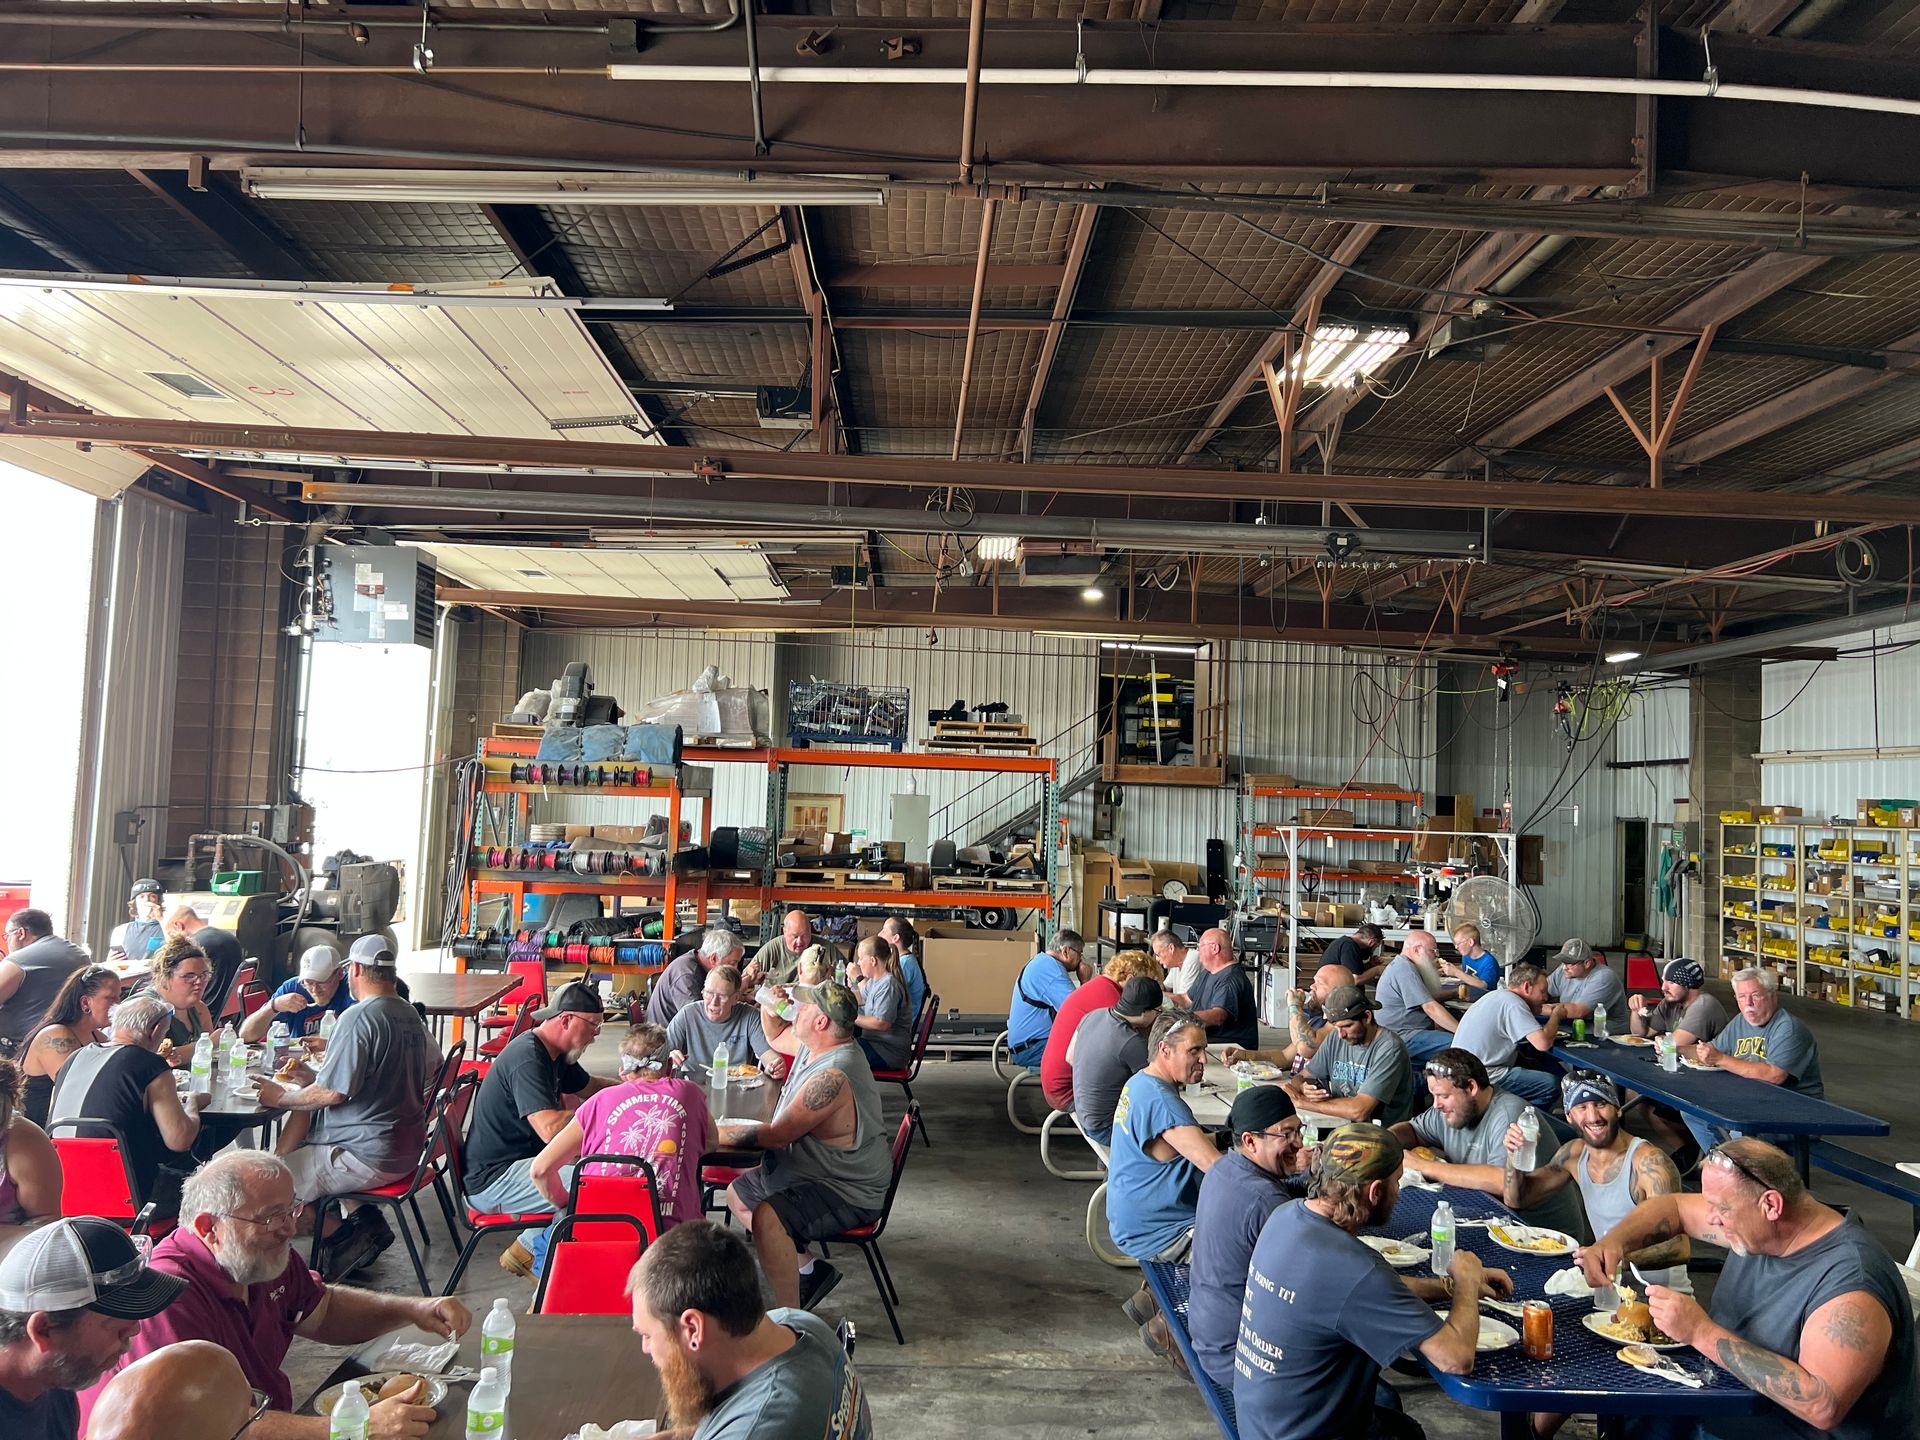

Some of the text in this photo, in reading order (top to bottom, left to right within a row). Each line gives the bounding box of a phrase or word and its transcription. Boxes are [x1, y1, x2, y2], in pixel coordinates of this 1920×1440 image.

[608, 1093, 687, 1126] SUMMER TIME
[671, 1122, 688, 1198] ADVENTURE
[1254, 1270, 1275, 1293] DOING
[1251, 1332, 1283, 1360] ORDER
